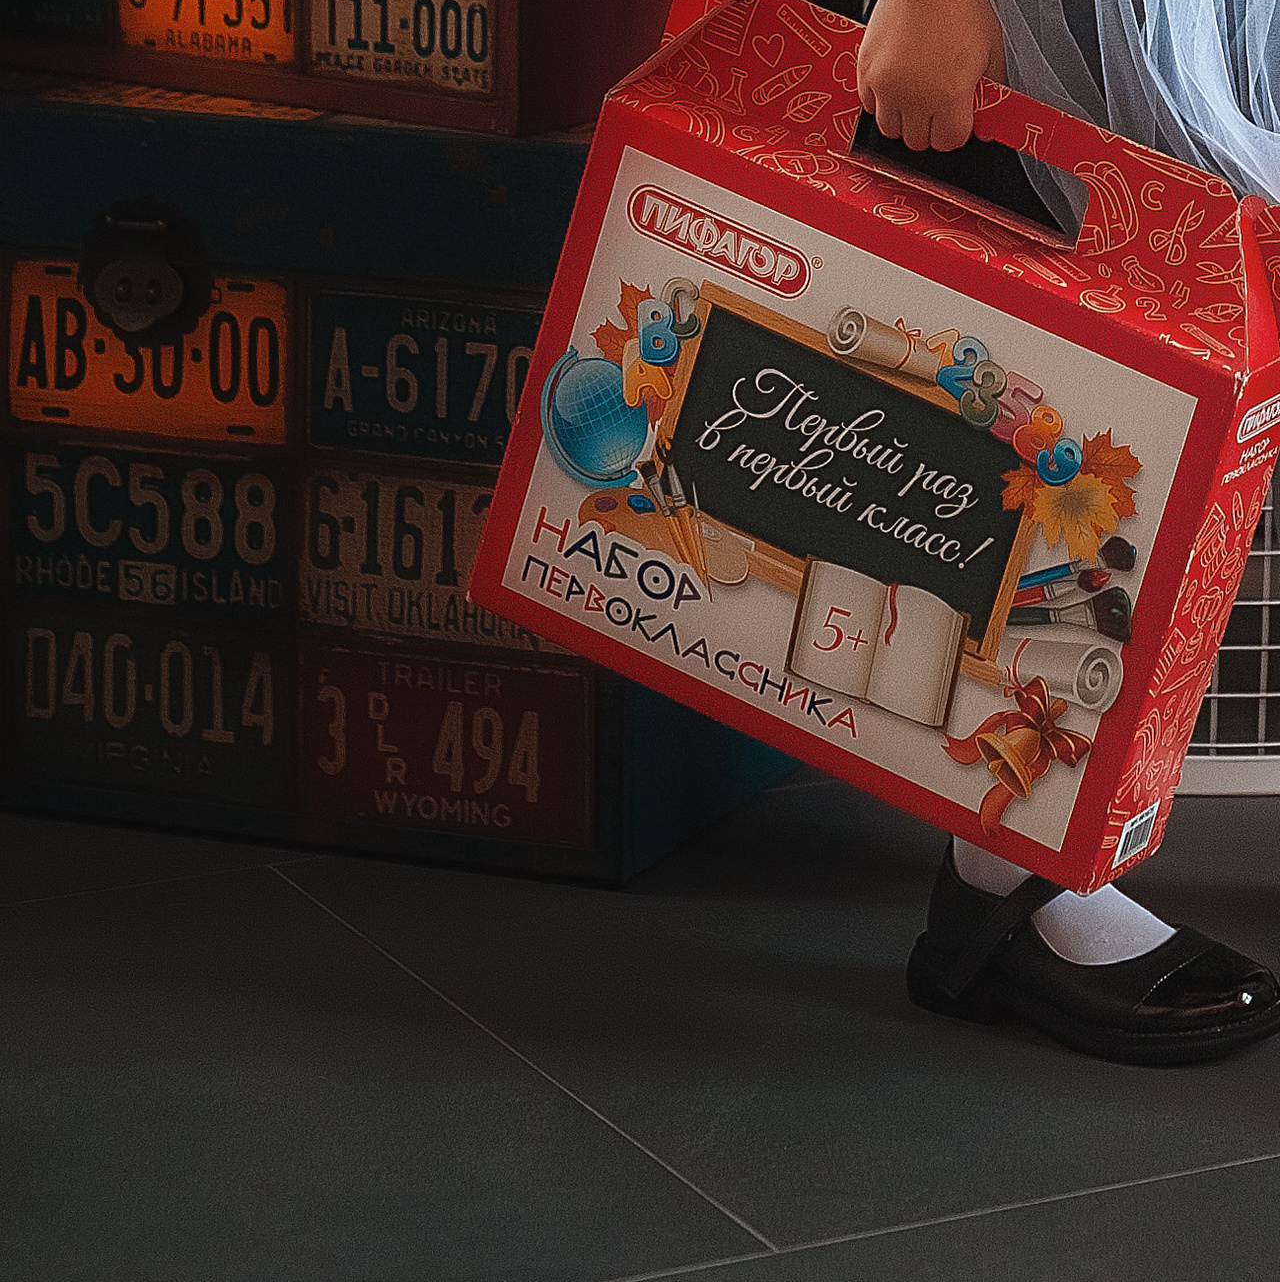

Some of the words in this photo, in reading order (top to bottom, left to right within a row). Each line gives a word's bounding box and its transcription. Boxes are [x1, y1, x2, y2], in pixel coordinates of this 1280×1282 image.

[165, 28, 252, 54] ALABAMA
[640, 192, 802, 287] ПИФАГОР
[401, 307, 498, 334] ARIZONA
[732, 368, 908, 475] Первый
[897, 463, 979, 519] раз
[25, 452, 277, 565] 5C588
[695, 408, 748, 451] в
[727, 448, 857, 513] первый
[857, 502, 995, 570] класс!
[15, 553, 112, 593] RHODE
[121, 562, 175, 603] 56
[181, 568, 283, 609] ISLAND
[532, 506, 702, 610] НАБОР
[388, 585, 540, 652] OKLAHO
[522, 554, 859, 739] ПЕРВОКЛАССНИКА
[812, 605, 869, 653] 5+
[377, 661, 503, 697] TRAILER
[431, 700, 541, 804] 494
[374, 788, 514, 829] WYOMING
